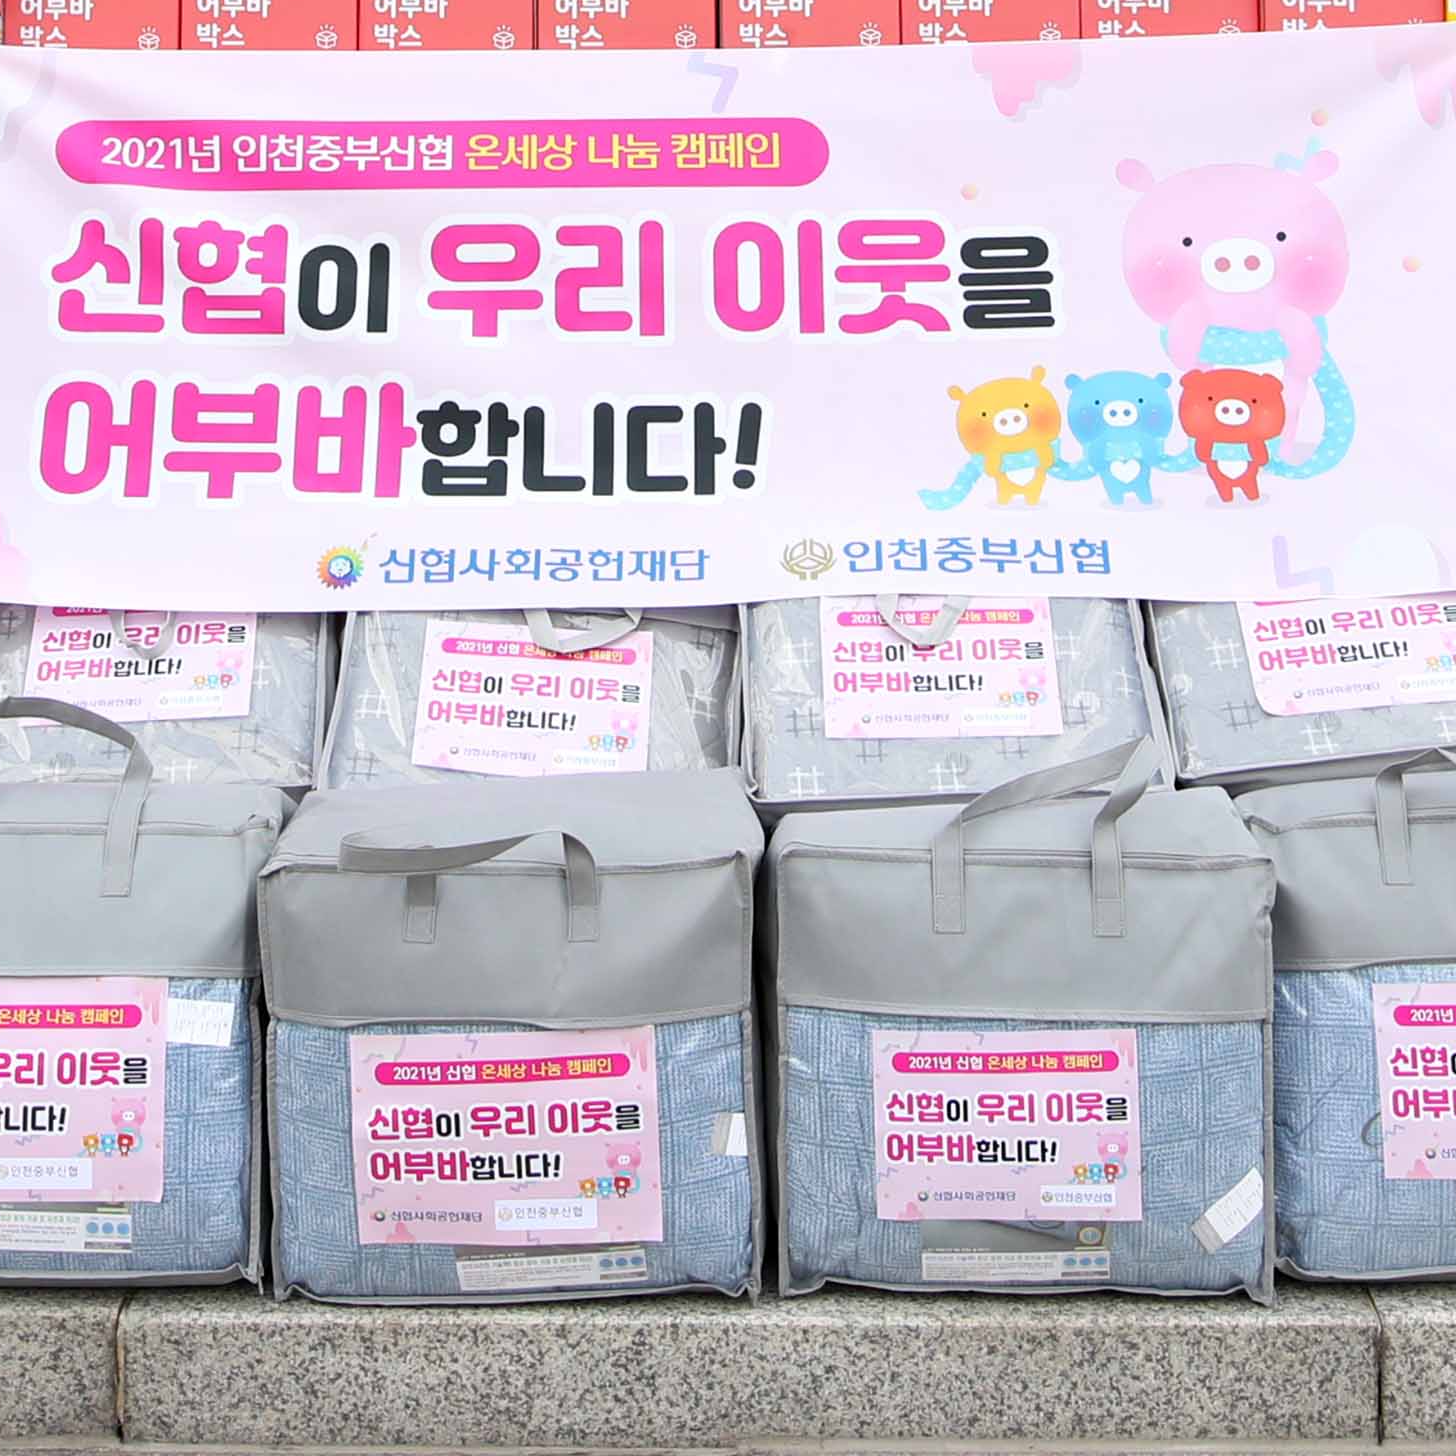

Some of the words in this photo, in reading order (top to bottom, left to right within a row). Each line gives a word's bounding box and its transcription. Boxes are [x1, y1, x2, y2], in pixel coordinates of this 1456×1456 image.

[102, 135, 222, 175] 2021년
[232, 135, 454, 175] 인천중부신협
[466, 133, 577, 171] 온세상
[586, 134, 662, 171] 나눔
[671, 132, 781, 170] 캠페인
[52, 217, 389, 335] 신협이
[427, 221, 663, 337] 우리
[713, 217, 1056, 335] 이웃을
[39, 379, 762, 499] 어부바합니다!
[378, 546, 710, 585] 신협사회공헌재단
[842, 536, 1111, 577] 인천중부신협
[43, 625, 112, 652] 신협이
[177, 620, 247, 645] 이웃을
[1253, 615, 1326, 642] 신협이
[1332, 611, 1385, 634] 우리
[832, 637, 907, 663] 신협이
[912, 640, 964, 662] 우리
[972, 638, 1043, 662] 이웃을
[432, 668, 504, 696] 신협이
[510, 673, 561, 698] 우리
[570, 675, 641, 704] 이웃을
[427, 699, 576, 731] 어부바합니다!
[46, 1009, 75, 1024] 나눔
[1410, 1009, 1453, 1022] 2021년
[57, 1051, 147, 1085] 이웃을
[393, 1066, 441, 1081] 2021년
[446, 1065, 476, 1080] 신협
[481, 1063, 526, 1079] 온세상
[532, 1061, 561, 1077] 나눔
[368, 1107, 460, 1140] 신협이
[470, 1105, 534, 1137] 우리
[548, 1100, 640, 1134] 이웃을
[886, 1093, 968, 1123] 신협이
[977, 1093, 1034, 1123] 우리
[1046, 1092, 1127, 1121] 이웃을
[886, 1133, 1057, 1163] 어부바합니다!
[370, 1151, 561, 1182] 어부바합니다!
